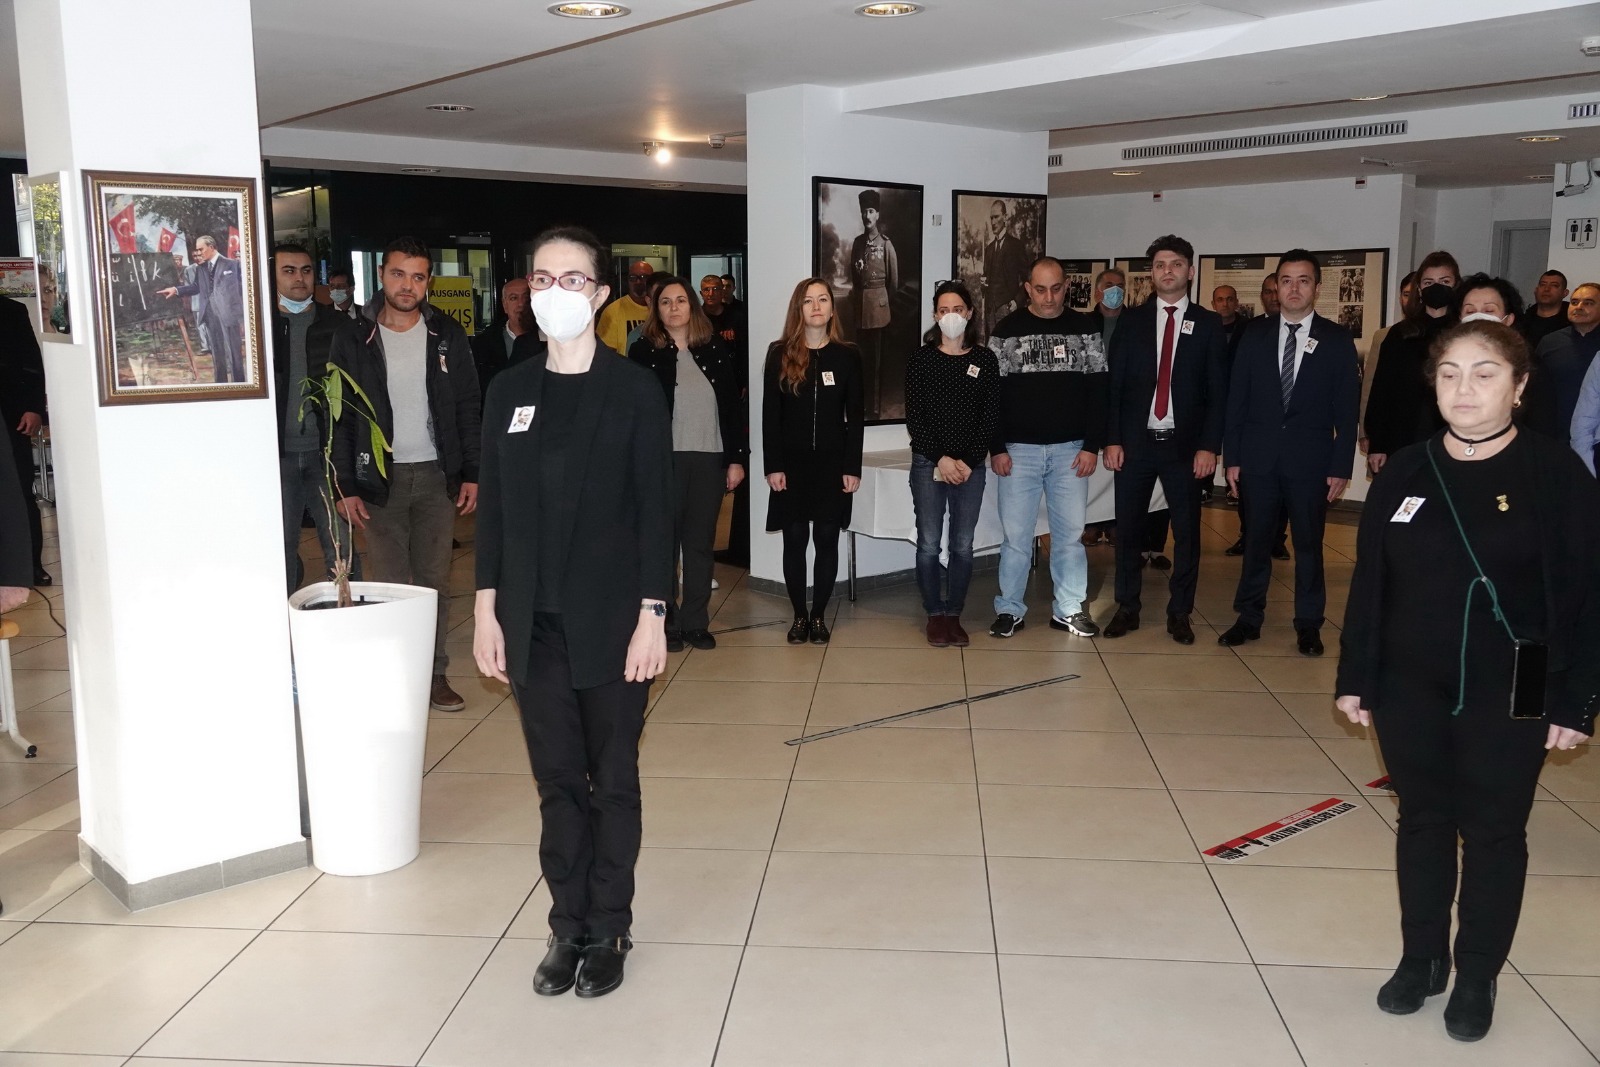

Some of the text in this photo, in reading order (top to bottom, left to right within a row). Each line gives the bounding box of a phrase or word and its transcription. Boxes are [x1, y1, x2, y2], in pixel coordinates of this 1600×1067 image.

[430, 290, 470, 298] AUSGANG
[1029, 339, 1052, 350] THERE
[1330, 802, 1357, 814] BITTE
[1294, 812, 1337, 829] ABSTAND
